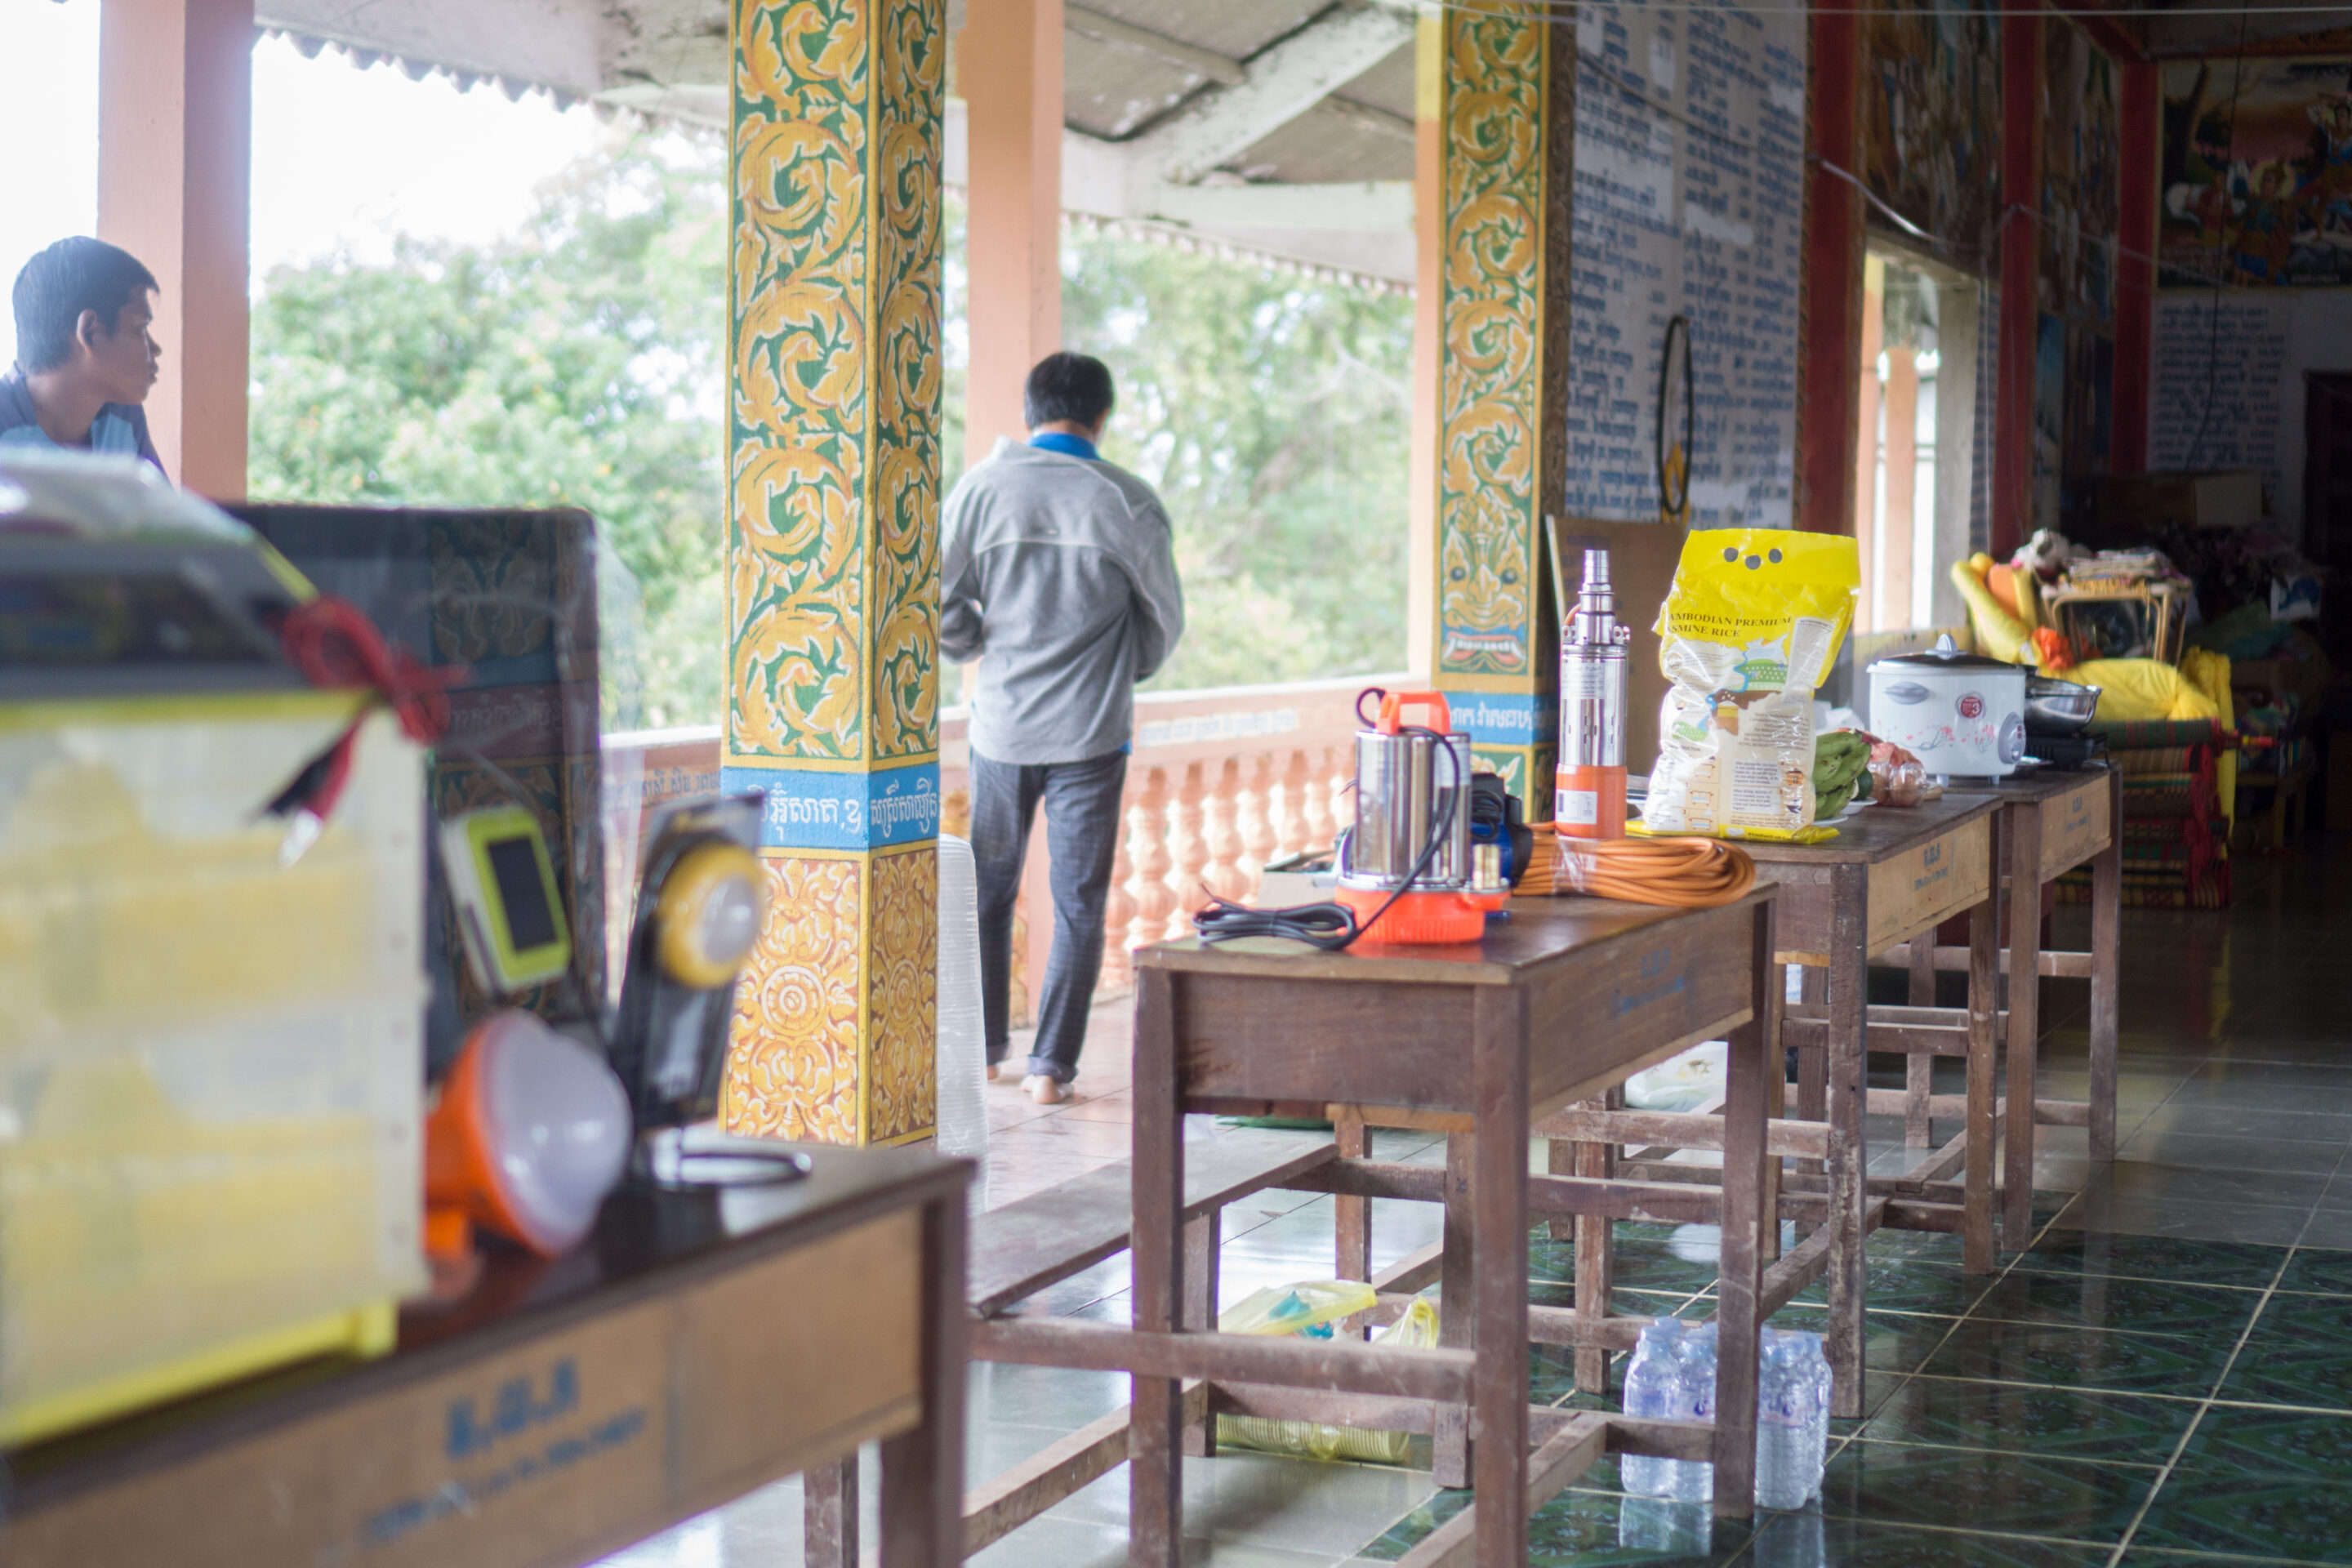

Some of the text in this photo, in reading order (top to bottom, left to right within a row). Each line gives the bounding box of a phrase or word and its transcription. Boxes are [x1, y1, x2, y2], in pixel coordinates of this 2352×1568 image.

[1668, 612, 1732, 626] AMBODIAN
[1735, 617, 1791, 627] PREMIUM
[1668, 624, 1740, 638] ASMINE RICE
